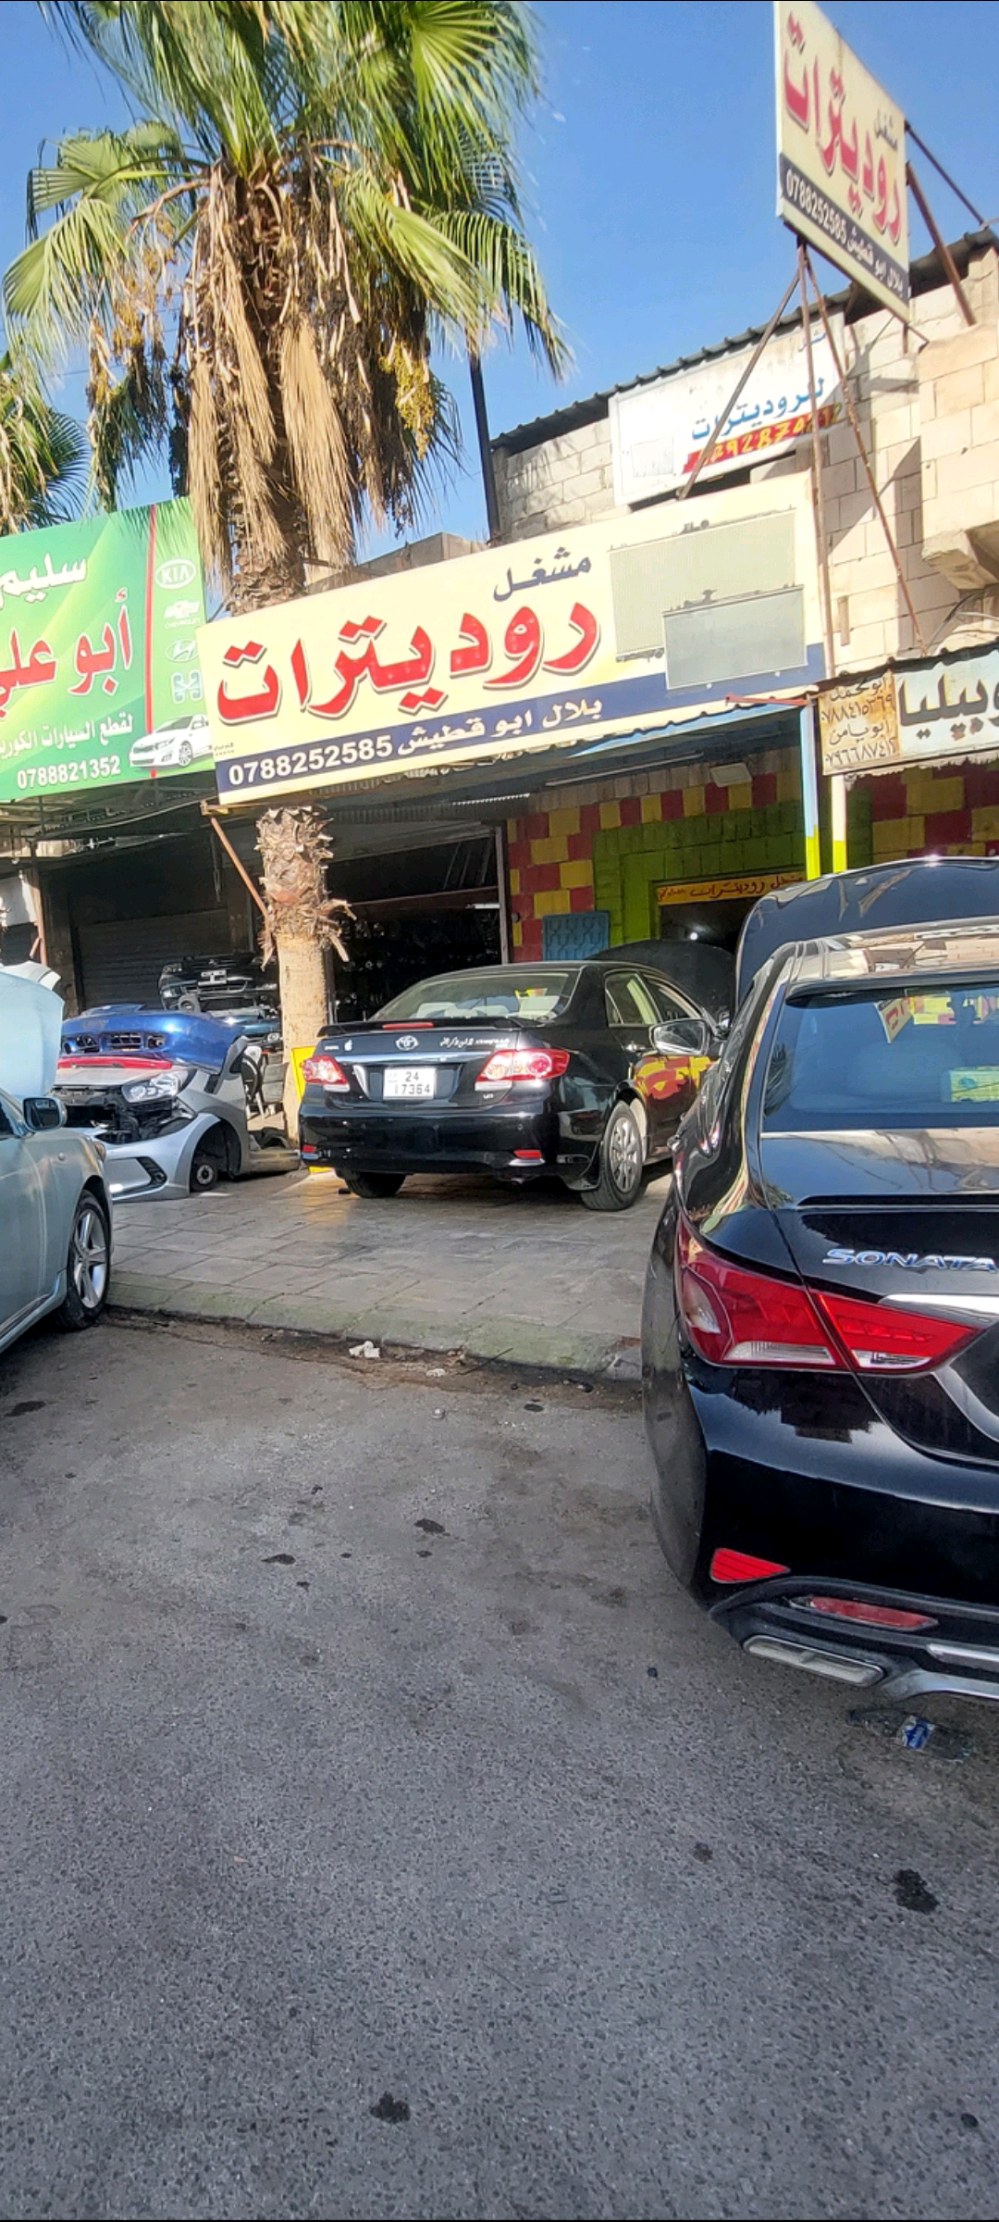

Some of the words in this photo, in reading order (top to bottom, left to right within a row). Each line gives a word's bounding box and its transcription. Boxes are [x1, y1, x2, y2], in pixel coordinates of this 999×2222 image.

[783, 11, 901, 246] روديترات
[786, 168, 847, 245] 0788252585
[160, 563, 191, 585] KIA
[494, 546, 592, 601] مشغل
[69, 587, 132, 696] أبو
[216, 601, 602, 726] روديترات
[100, 711, 133, 745] لقطع
[490, 708, 532, 738] ابو
[542, 698, 603, 728] بلال
[41, 719, 96, 750] السيارات
[397, 716, 485, 755] قطيش
[17, 755, 121, 790] 0788821352
[228, 734, 393, 786] 0788252585
[405, 1070, 420, 1083] 24
[822, 1248, 999, 1274] SONATA
